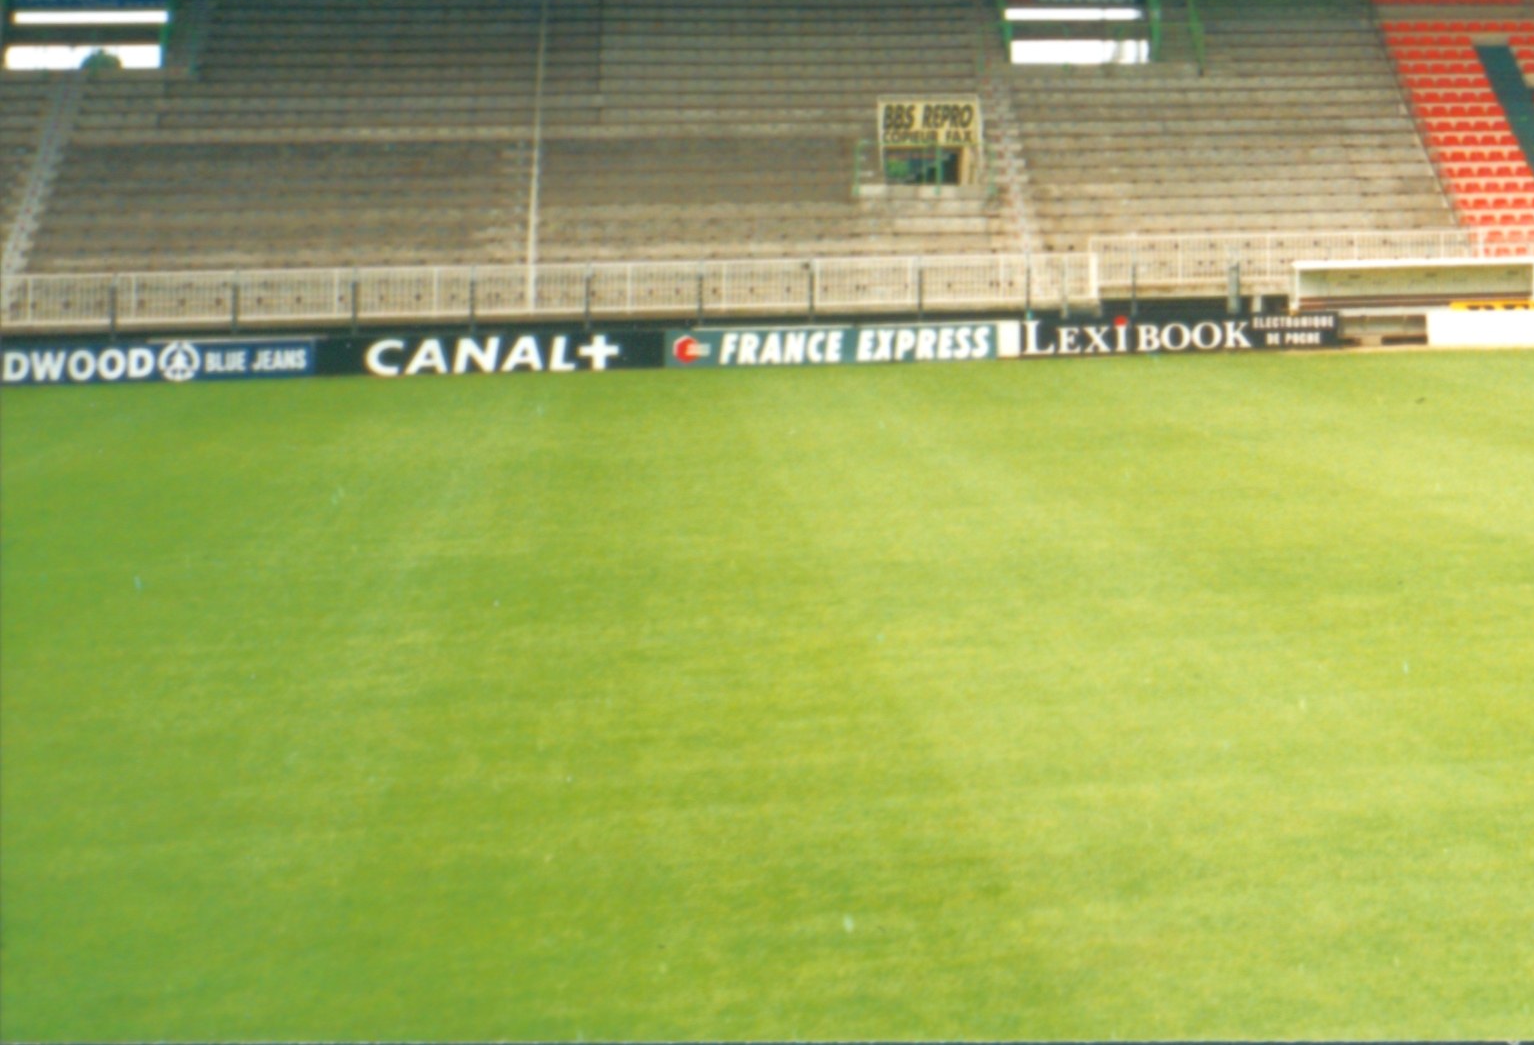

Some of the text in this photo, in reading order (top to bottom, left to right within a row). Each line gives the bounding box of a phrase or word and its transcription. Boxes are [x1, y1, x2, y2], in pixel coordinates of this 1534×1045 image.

[922, 104, 973, 128] REPRO
[945, 130, 972, 143] FAX
[365, 334, 620, 375] CANAL+
[718, 326, 990, 365] FRANCE EXPRESS
[2, 347, 155, 382] DWOOD
[205, 349, 307, 373] BLUE JEANS
